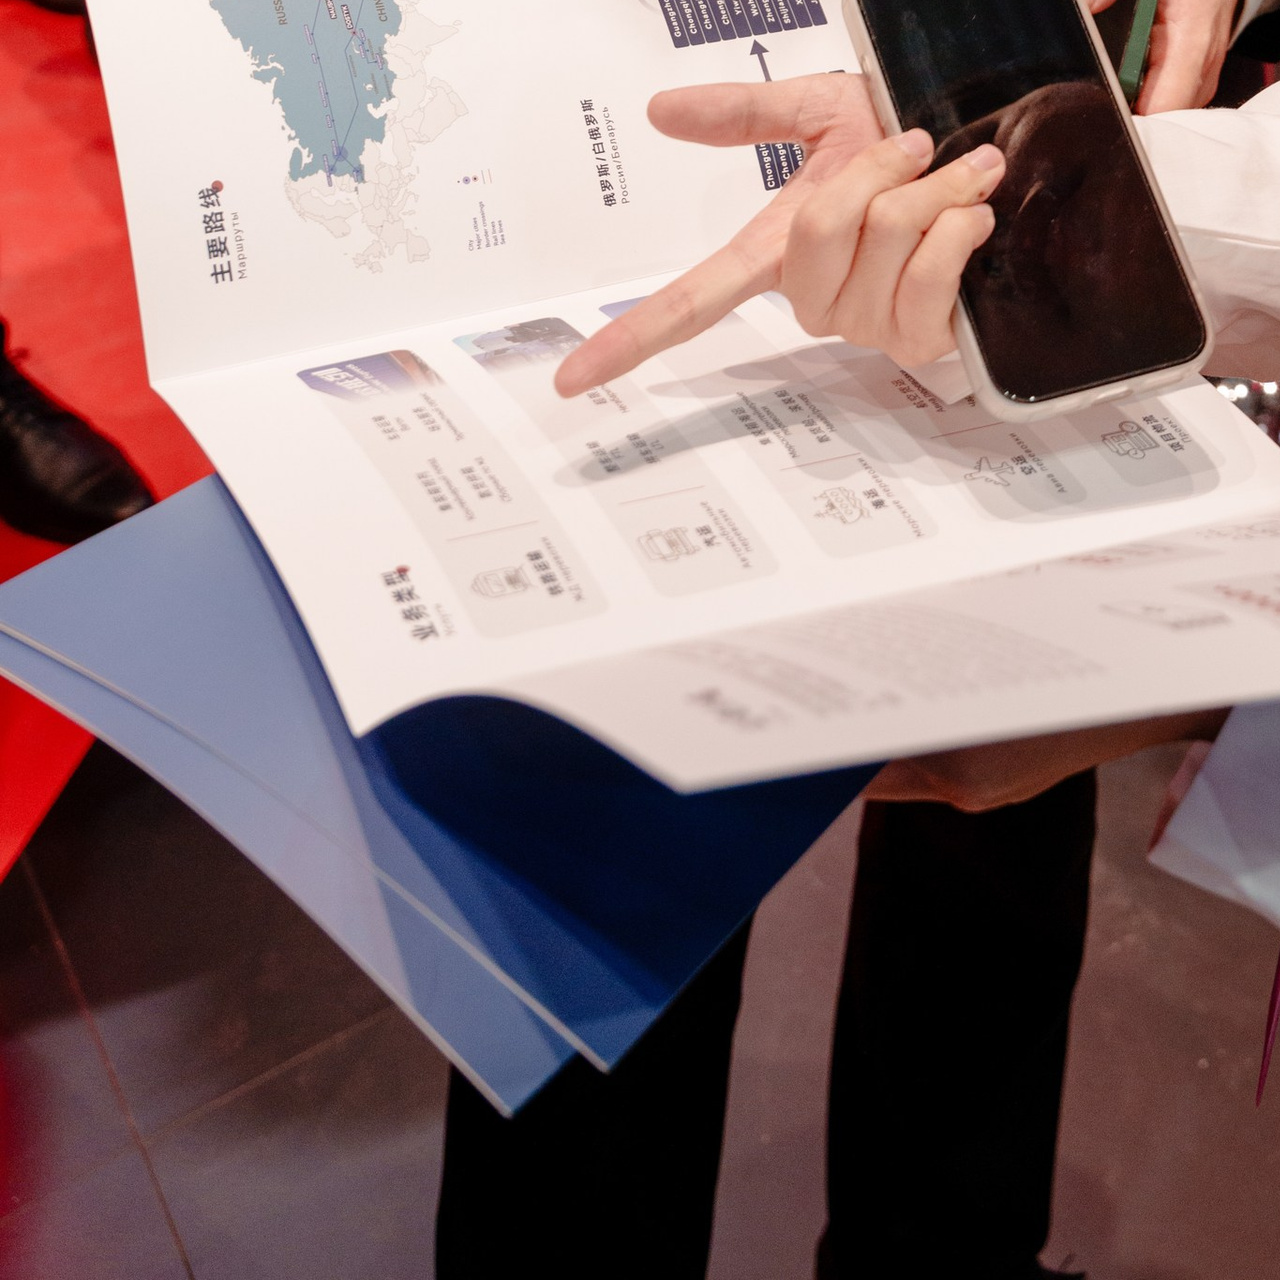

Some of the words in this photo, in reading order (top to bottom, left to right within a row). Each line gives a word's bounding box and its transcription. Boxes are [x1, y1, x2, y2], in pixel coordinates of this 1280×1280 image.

[342, 5, 353, 29] DOSTYK
[580, 98, 617, 207] 俄罗斯/白俄罗斯
[603, 106, 630, 205] Россия/Беларусь
[758, 142, 776, 188] Chongqin
[774, 142, 791, 179] Chengd
[479, 201, 487, 227] crossings
[198, 186, 233, 284] 主要路线
[231, 212, 248, 280] Маршруты
[585, 386, 608, 405] 超限
[891, 378, 928, 409] 航空货运
[1144, 413, 1186, 452] 项目物流
[1163, 415, 1192, 443] Проект
[1009, 432, 1048, 472] перевозки
[1013, 454, 1037, 476] 空运
[857, 456, 894, 497] перевозки
[1046, 473, 1068, 493] Авиа
[863, 489, 889, 510] 海运
[891, 499, 925, 537] Морские
[695, 524, 722, 549] 汽运
[699, 500, 752, 568] Автомобильные
[718, 507, 753, 553] перевозки
[527, 550, 564, 597] 铁路运输
[381, 570, 440, 642] 业务类型
